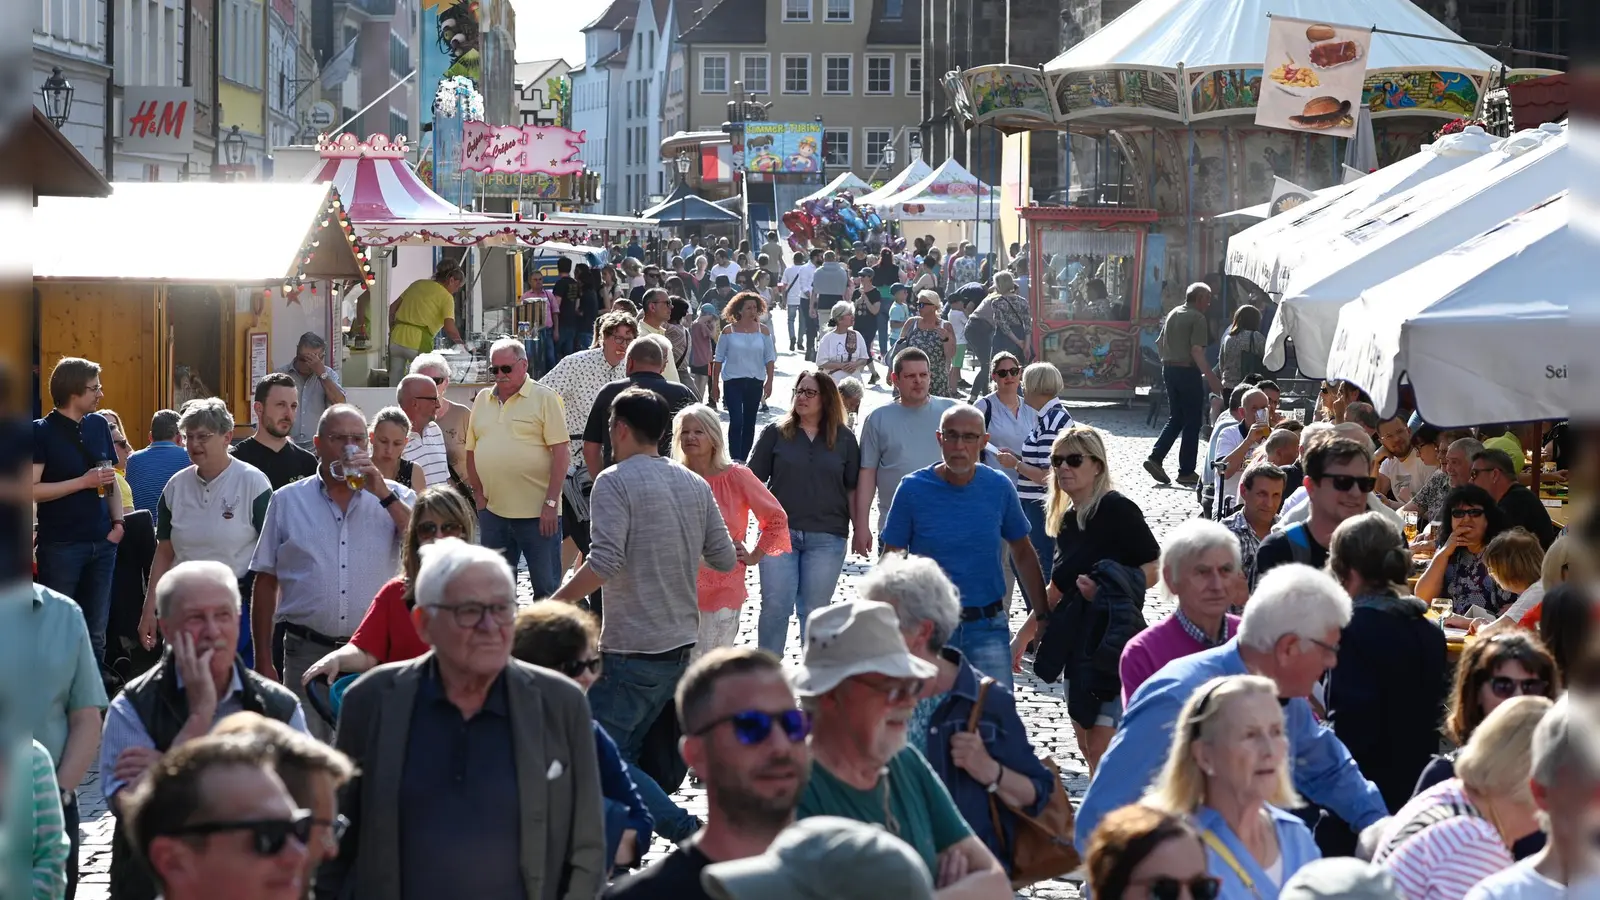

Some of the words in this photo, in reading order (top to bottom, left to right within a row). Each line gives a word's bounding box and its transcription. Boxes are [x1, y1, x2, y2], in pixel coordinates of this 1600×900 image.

[129, 101, 187, 139] H&M
[492, 139, 516, 159] Crêpes
[1545, 364, 1567, 379] Sei
